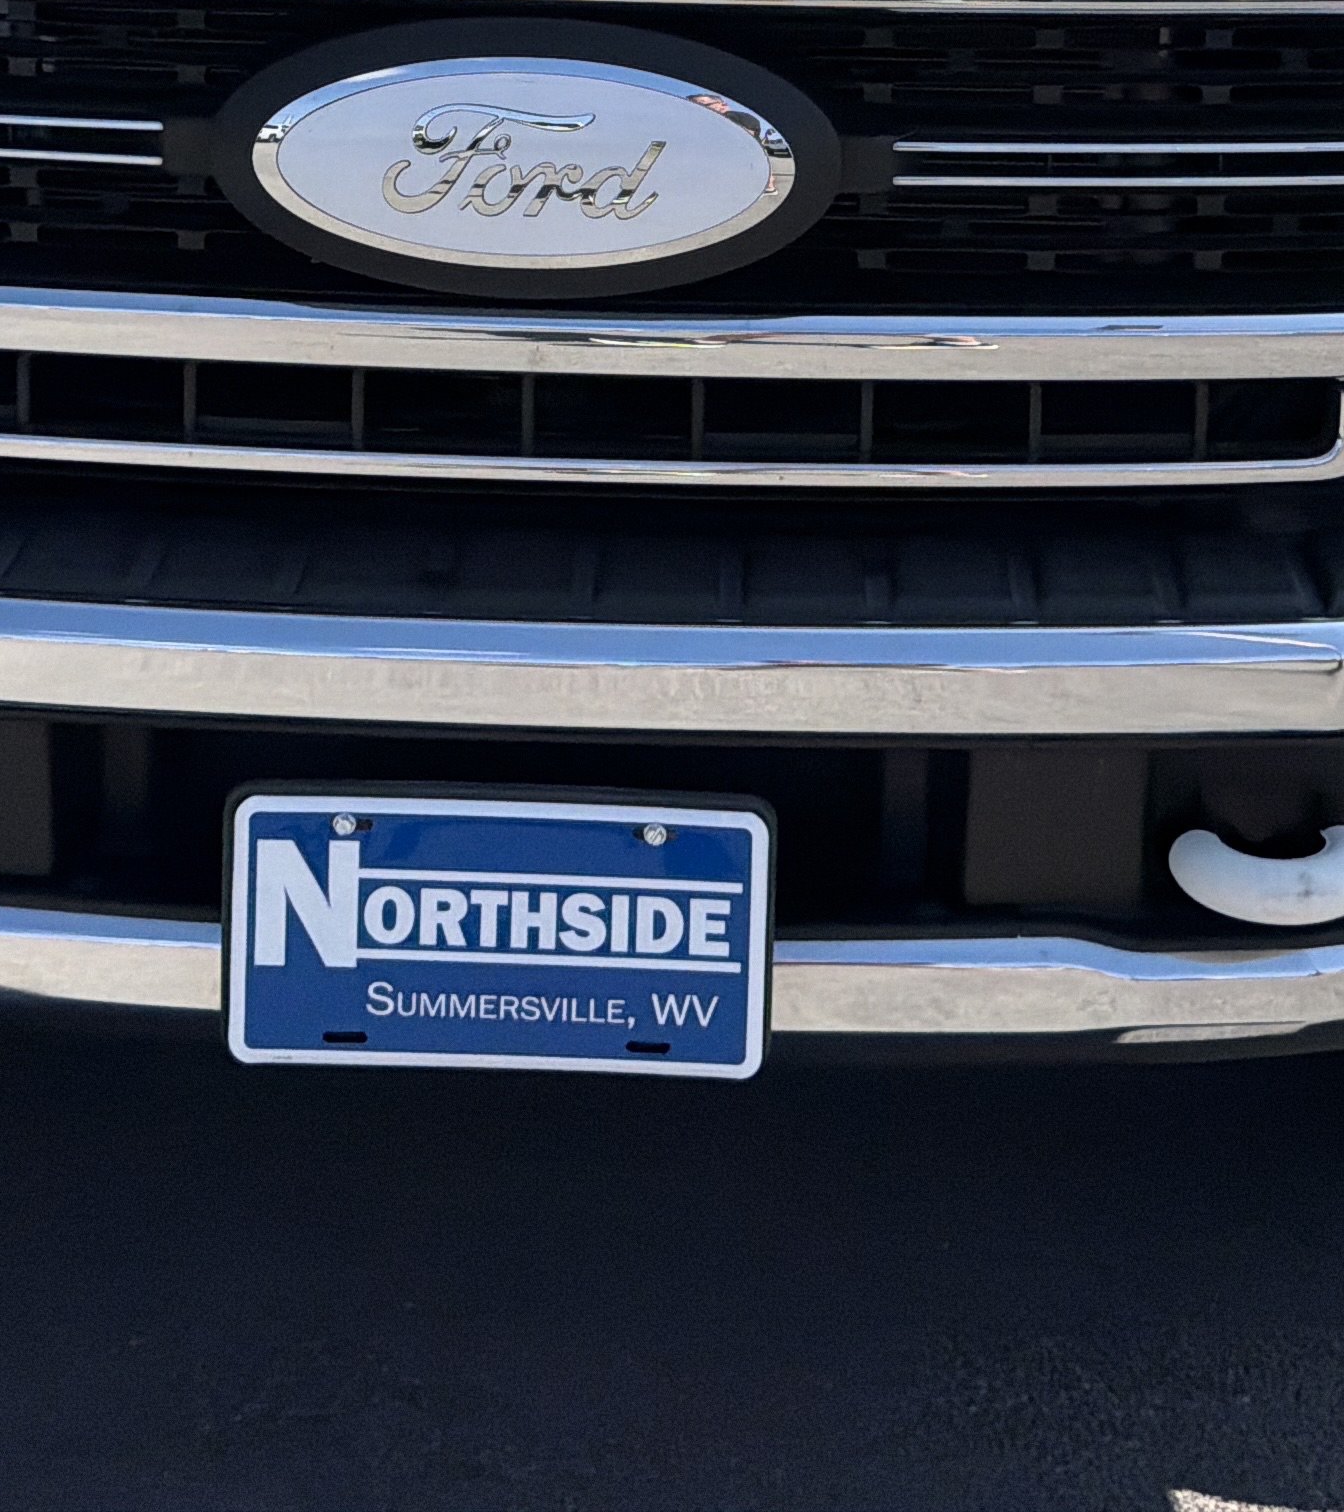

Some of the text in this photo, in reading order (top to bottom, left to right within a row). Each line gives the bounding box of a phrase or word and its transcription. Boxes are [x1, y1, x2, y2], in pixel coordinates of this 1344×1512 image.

[381, 102, 667, 221] Ford
[253, 838, 733, 969] NORTHSIDE
[365, 981, 720, 1029] SUMMERSVILLE, WV
